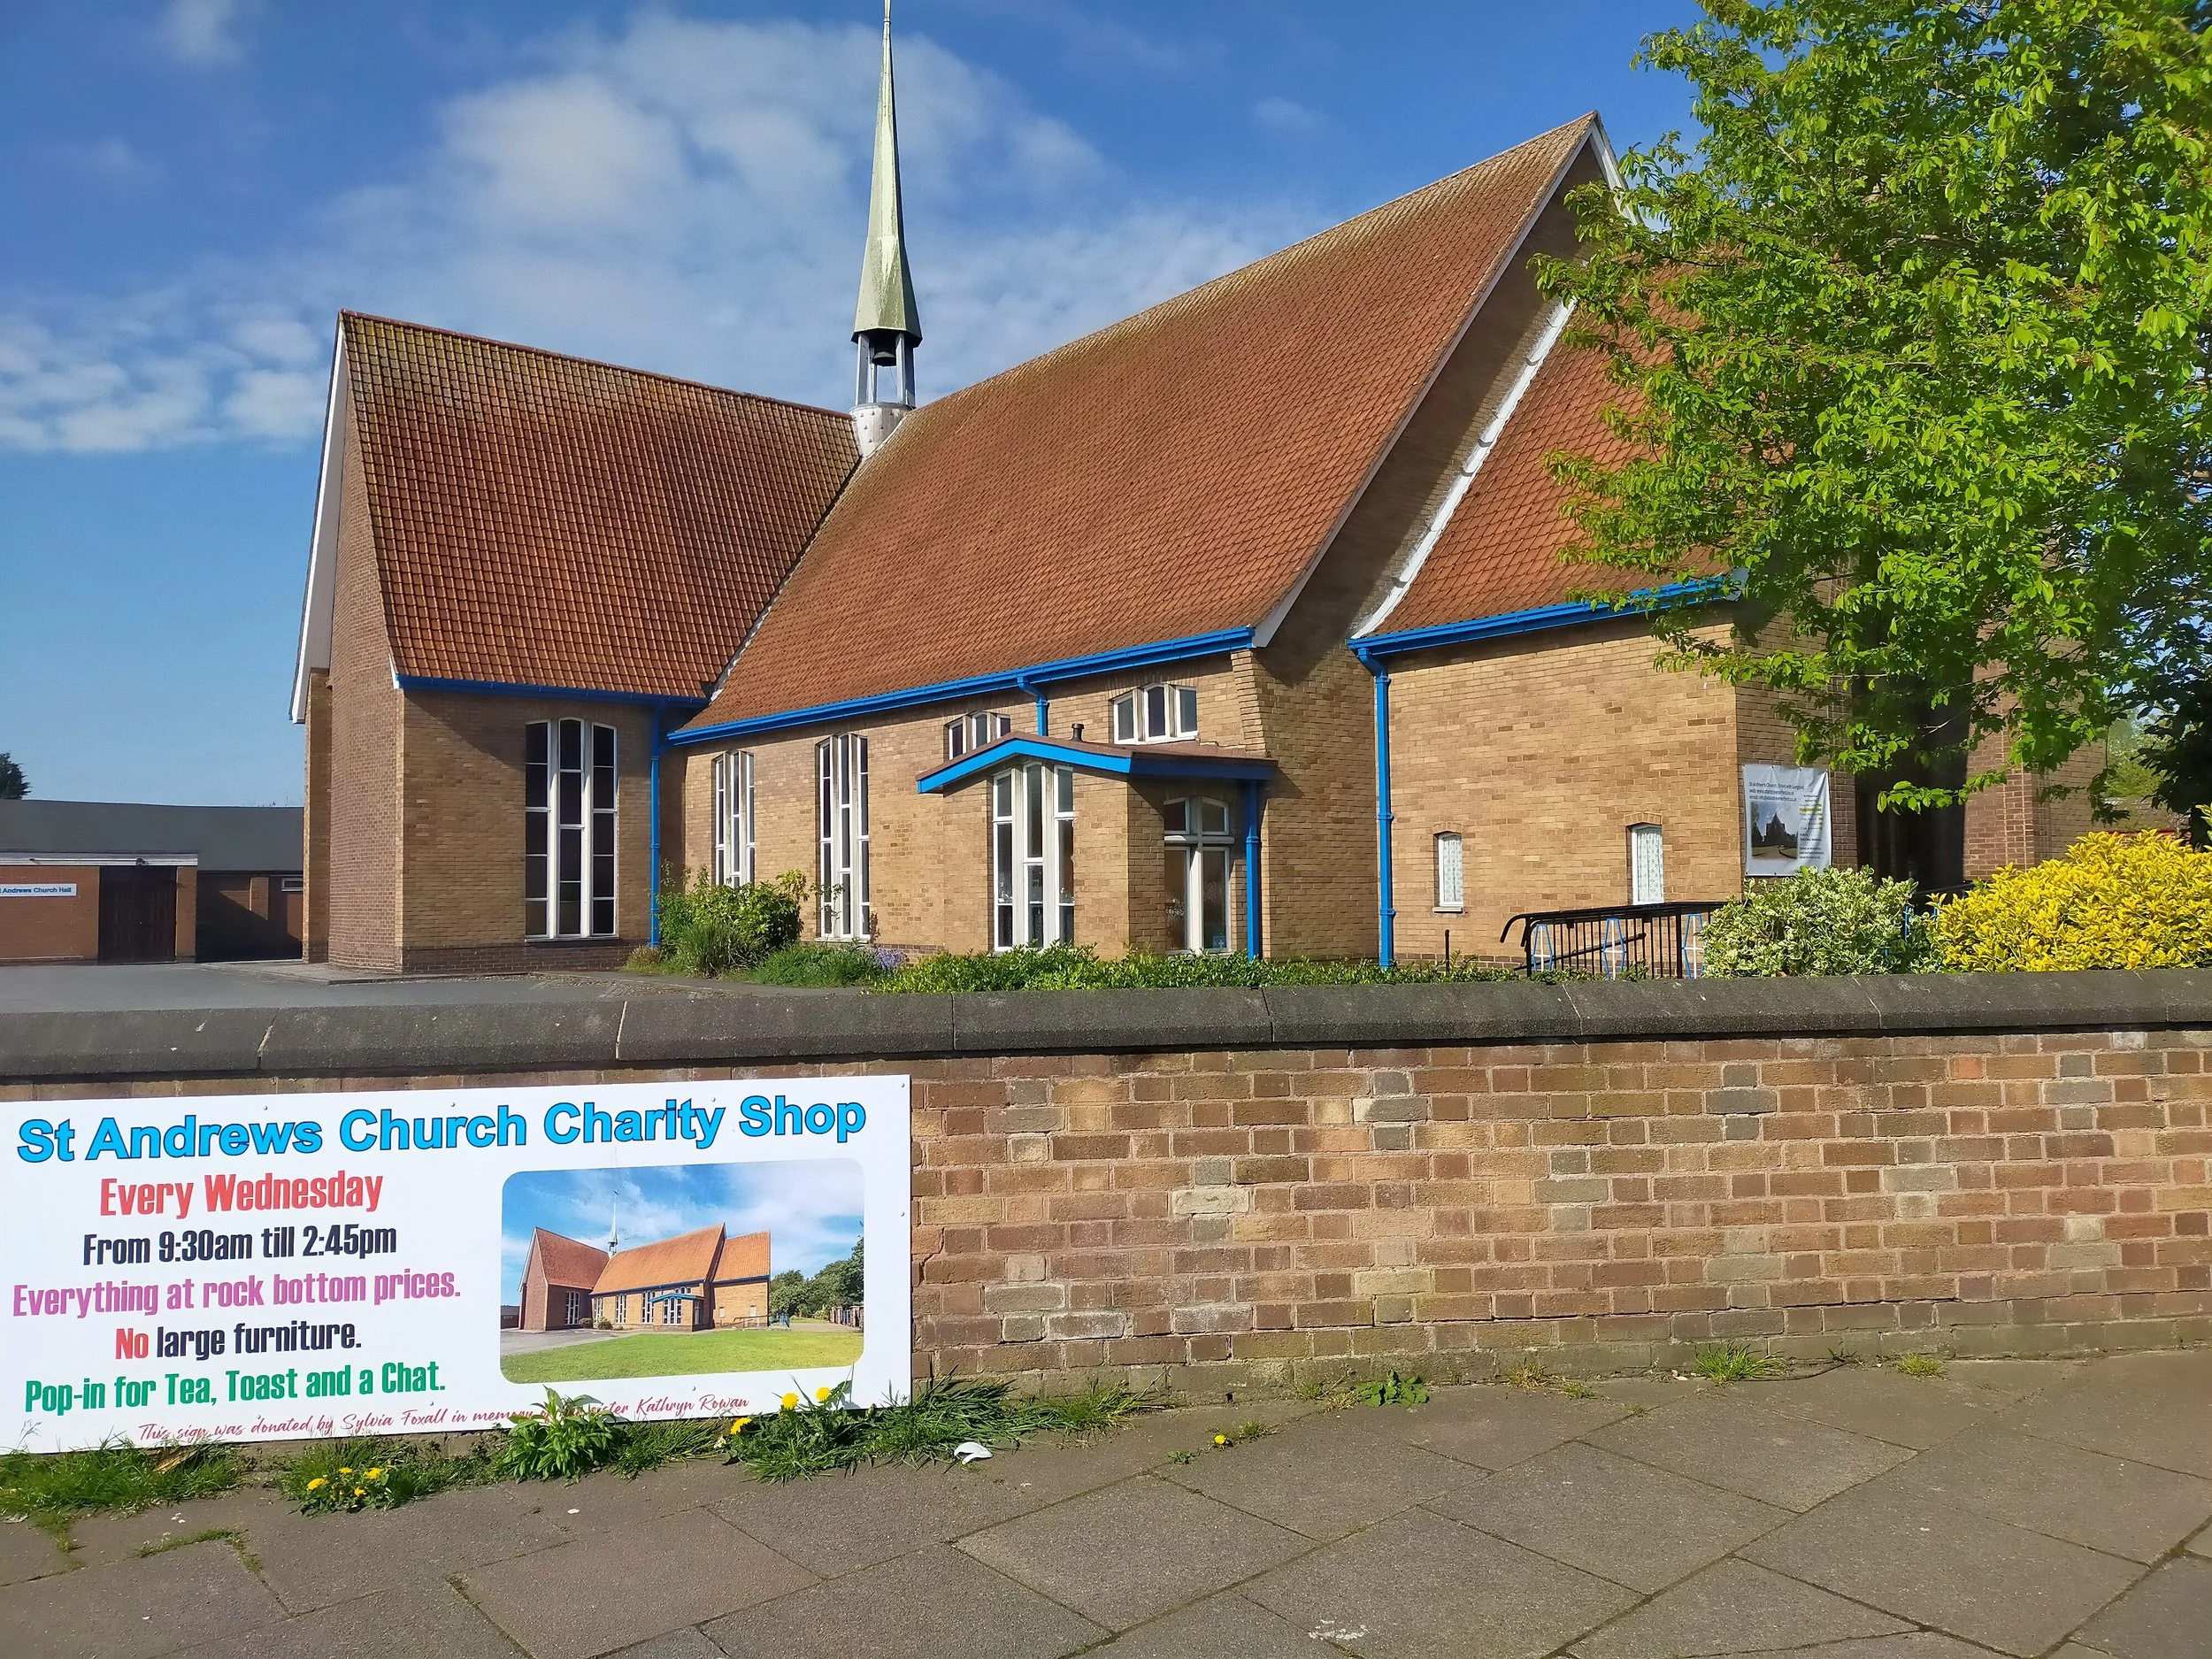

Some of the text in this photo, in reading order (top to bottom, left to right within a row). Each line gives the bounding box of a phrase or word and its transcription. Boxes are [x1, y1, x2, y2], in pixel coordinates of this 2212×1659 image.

[17, 1095, 866, 1163] St Andrews Church Charity Shop
[101, 1171, 383, 1219] Every Wednesday
[83, 1224, 396, 1265] From 9:30am till 2:45pm
[13, 1269, 460, 1318] Everything at rock bottom prices.
[116, 1320, 361, 1361] No large furniture.
[26, 1362, 445, 1416] Pop-in for Tea, Toast and a Chat.
[139, 1424, 170, 1440] This
[177, 1425, 209, 1444] sign
[214, 1424, 244, 1436] was
[250, 1416, 313, 1433] donated
[317, 1415, 334, 1434] by
[341, 1412, 394, 1433] Sylvia
[401, 1409, 449, 1426] Foxall
[451, 1409, 467, 1424] in
[591, 1401, 628, 1416] siter
[636, 1396, 695, 1416] Kathryn
[699, 1394, 749, 1409] Rowan
